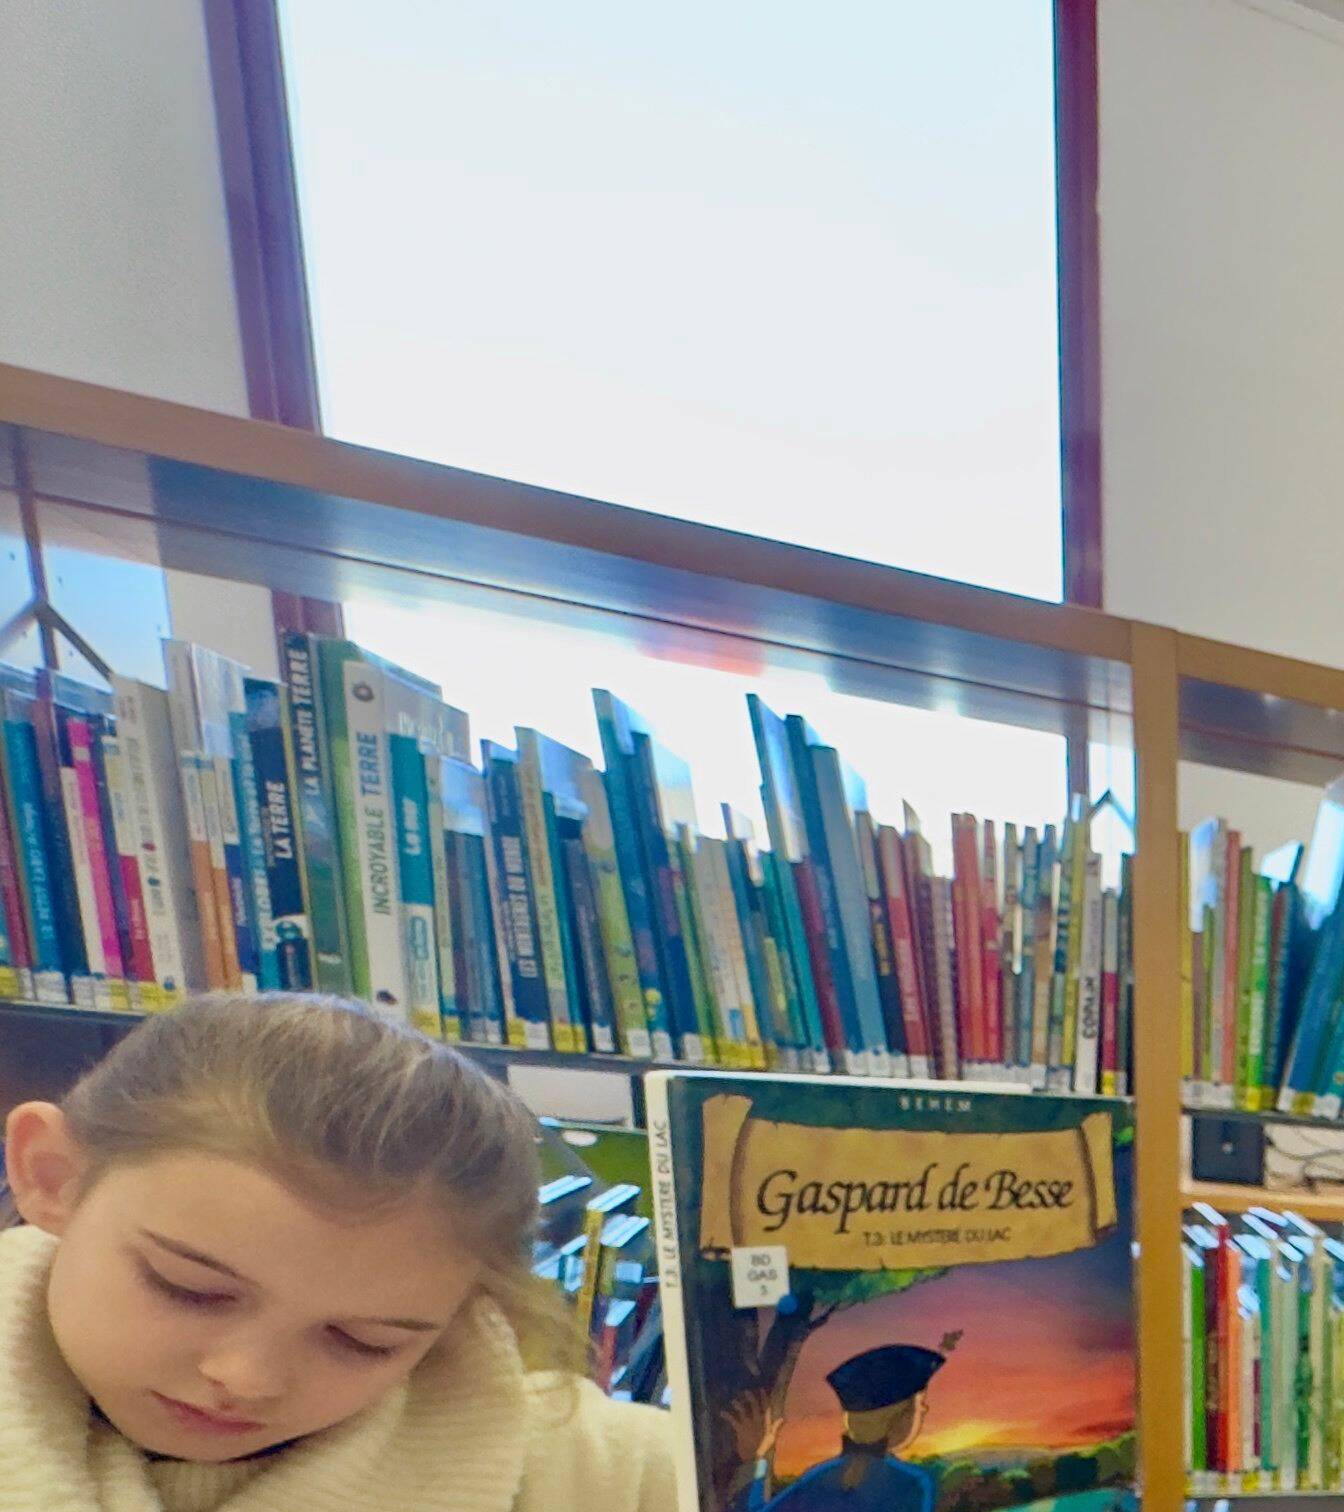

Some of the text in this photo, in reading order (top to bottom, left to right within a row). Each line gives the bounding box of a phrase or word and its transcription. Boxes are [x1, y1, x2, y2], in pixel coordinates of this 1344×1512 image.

[287, 649, 313, 705] TERRE
[304, 775, 321, 796] LA
[265, 779, 291, 834] TERRE
[356, 732, 392, 916] INCROYABLE TERRE
[273, 835, 294, 860] LA
[653, 1119, 668, 1149] LAC
[656, 1152, 671, 1175] DU
[757, 1162, 1075, 1234] Gaspard de Besse
[889, 1230, 905, 1246] LE
[965, 1229, 985, 1244] DU
[985, 1226, 1012, 1243] LAC
[662, 1245, 677, 1261] LE
